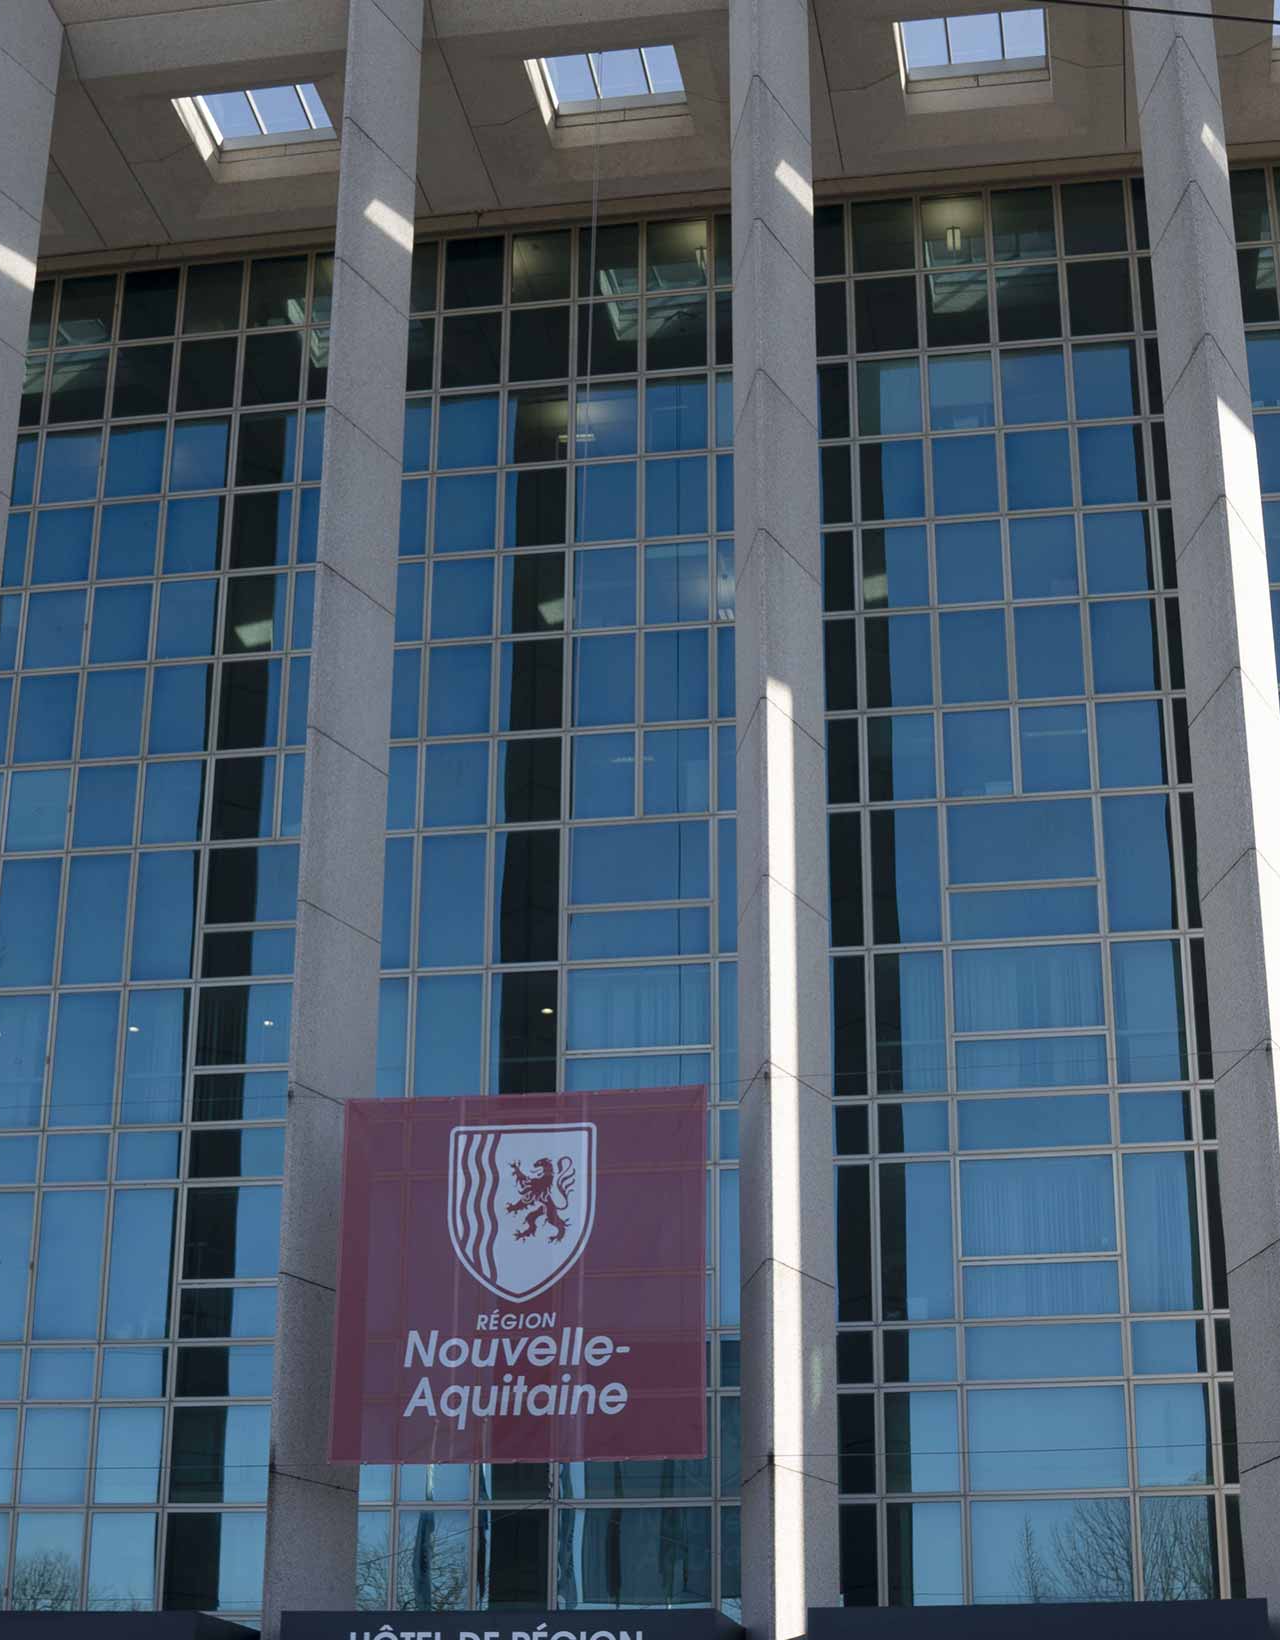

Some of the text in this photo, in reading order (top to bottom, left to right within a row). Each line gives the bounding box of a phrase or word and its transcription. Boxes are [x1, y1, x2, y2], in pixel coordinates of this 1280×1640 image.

[476, 1309, 557, 1331] RÉGION
[403, 1326, 631, 1368] Nouvelle-
[403, 1373, 628, 1431] Aquitaine
